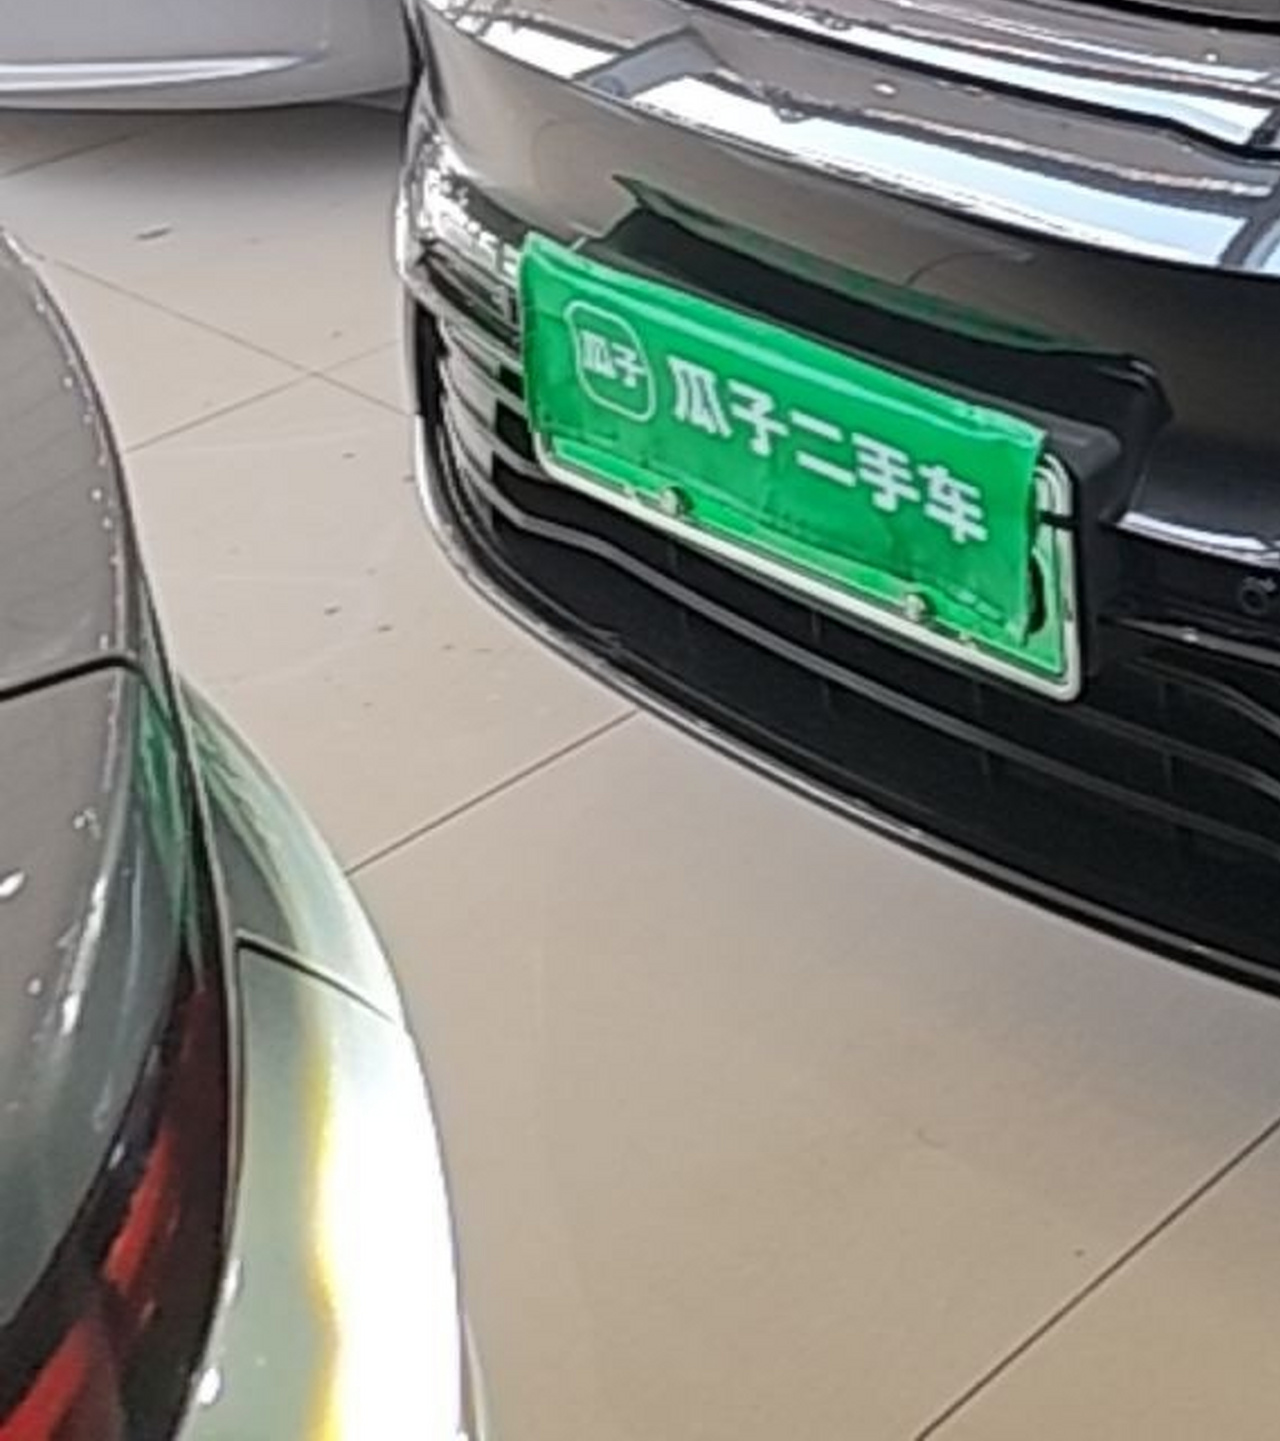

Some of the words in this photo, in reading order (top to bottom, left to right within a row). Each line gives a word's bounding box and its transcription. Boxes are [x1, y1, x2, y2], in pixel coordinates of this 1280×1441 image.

[580, 329, 646, 388] 瓜子
[667, 355, 988, 544] 瓜子二手车
